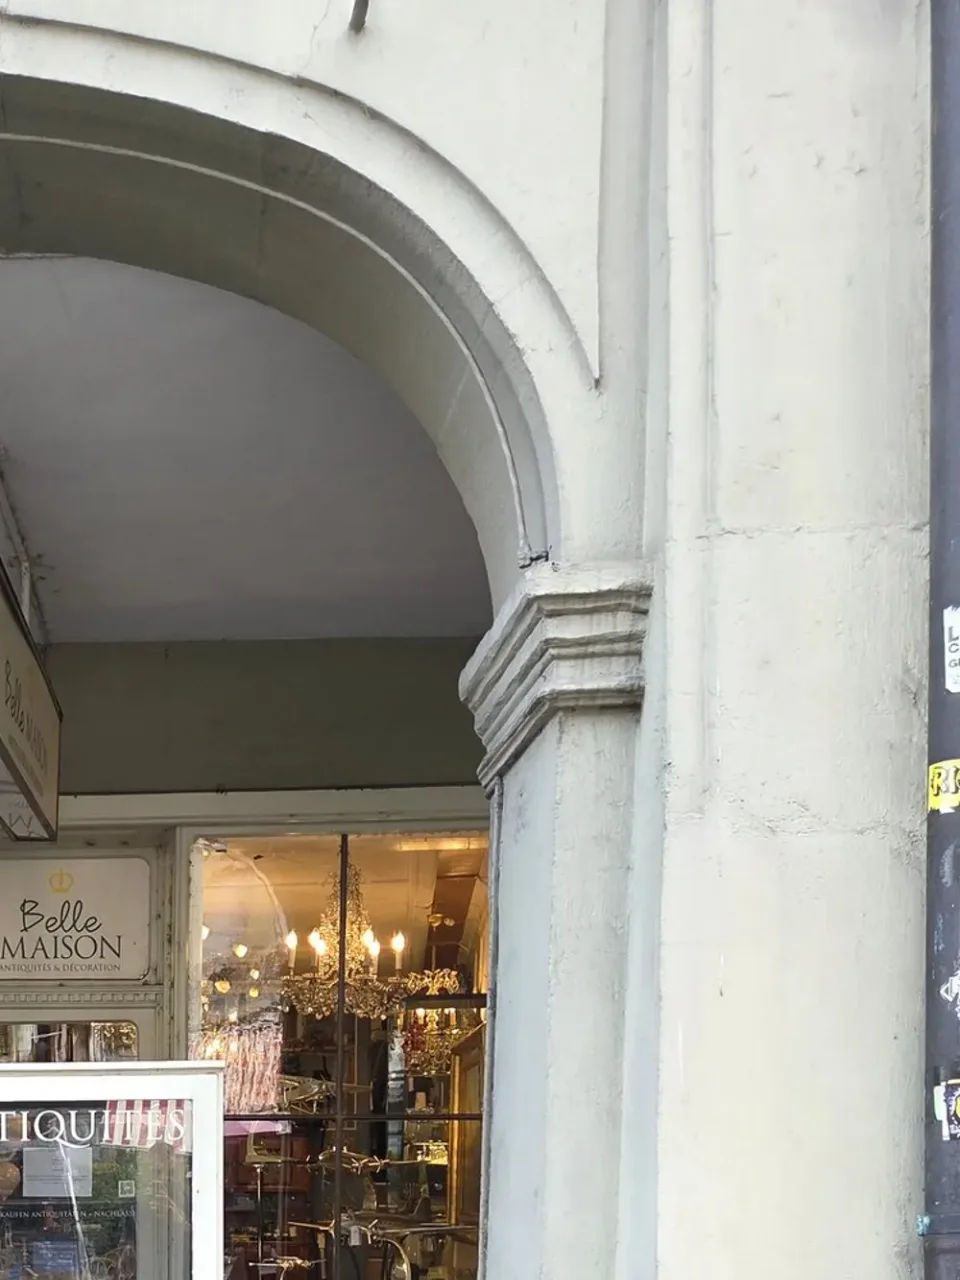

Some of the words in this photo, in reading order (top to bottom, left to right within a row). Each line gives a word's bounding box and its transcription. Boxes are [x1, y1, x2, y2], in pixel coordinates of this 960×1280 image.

[20, 898, 102, 933] Belle
[0, 935, 122, 960] MAISON
[0, 963, 52, 973] ANTIQUITÉS
[53, 964, 60, 972] &
[62, 963, 121, 973] DÉCORATION
